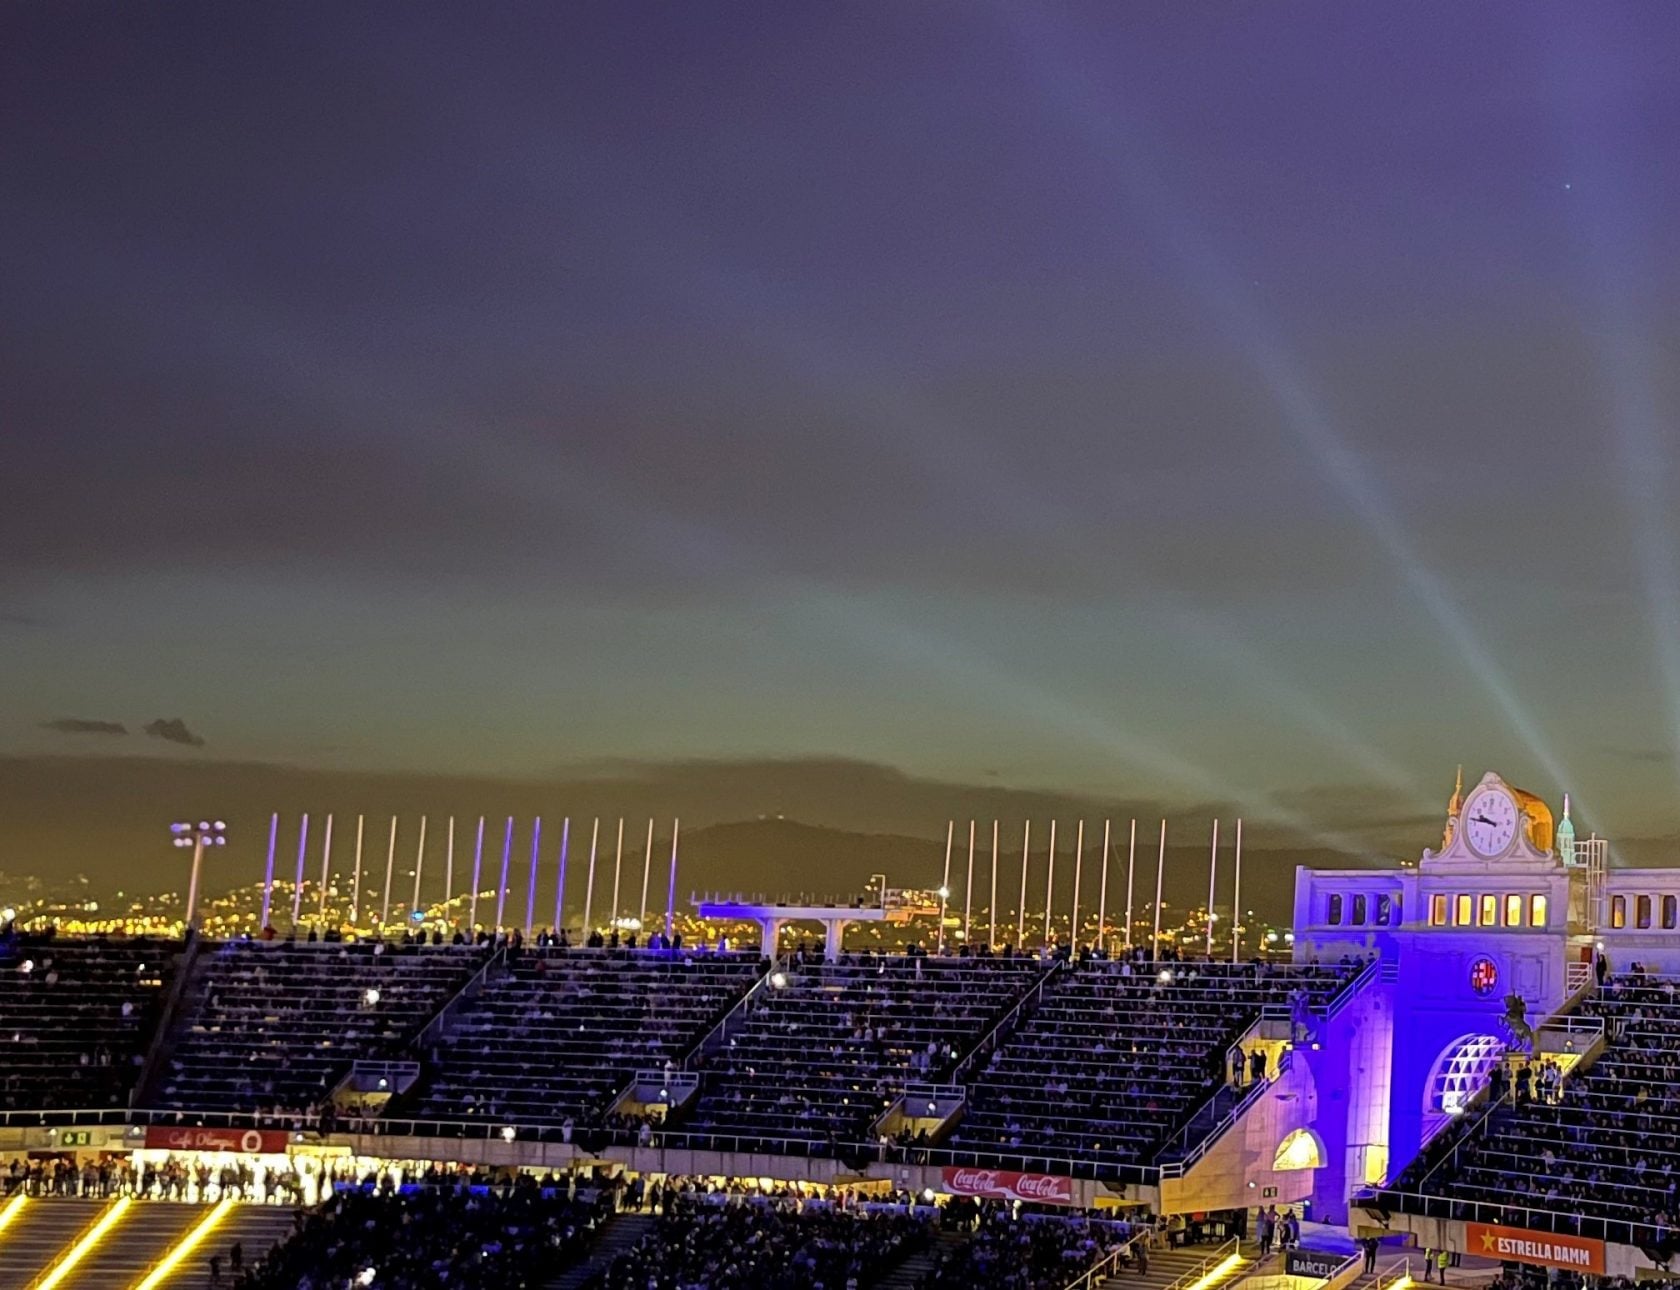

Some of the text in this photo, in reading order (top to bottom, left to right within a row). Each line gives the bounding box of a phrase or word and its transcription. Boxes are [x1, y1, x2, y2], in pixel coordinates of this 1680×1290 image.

[1497, 1237, 1590, 1266] ESTRELLA DAMM
[1293, 1260, 1340, 1276] BARCELO
